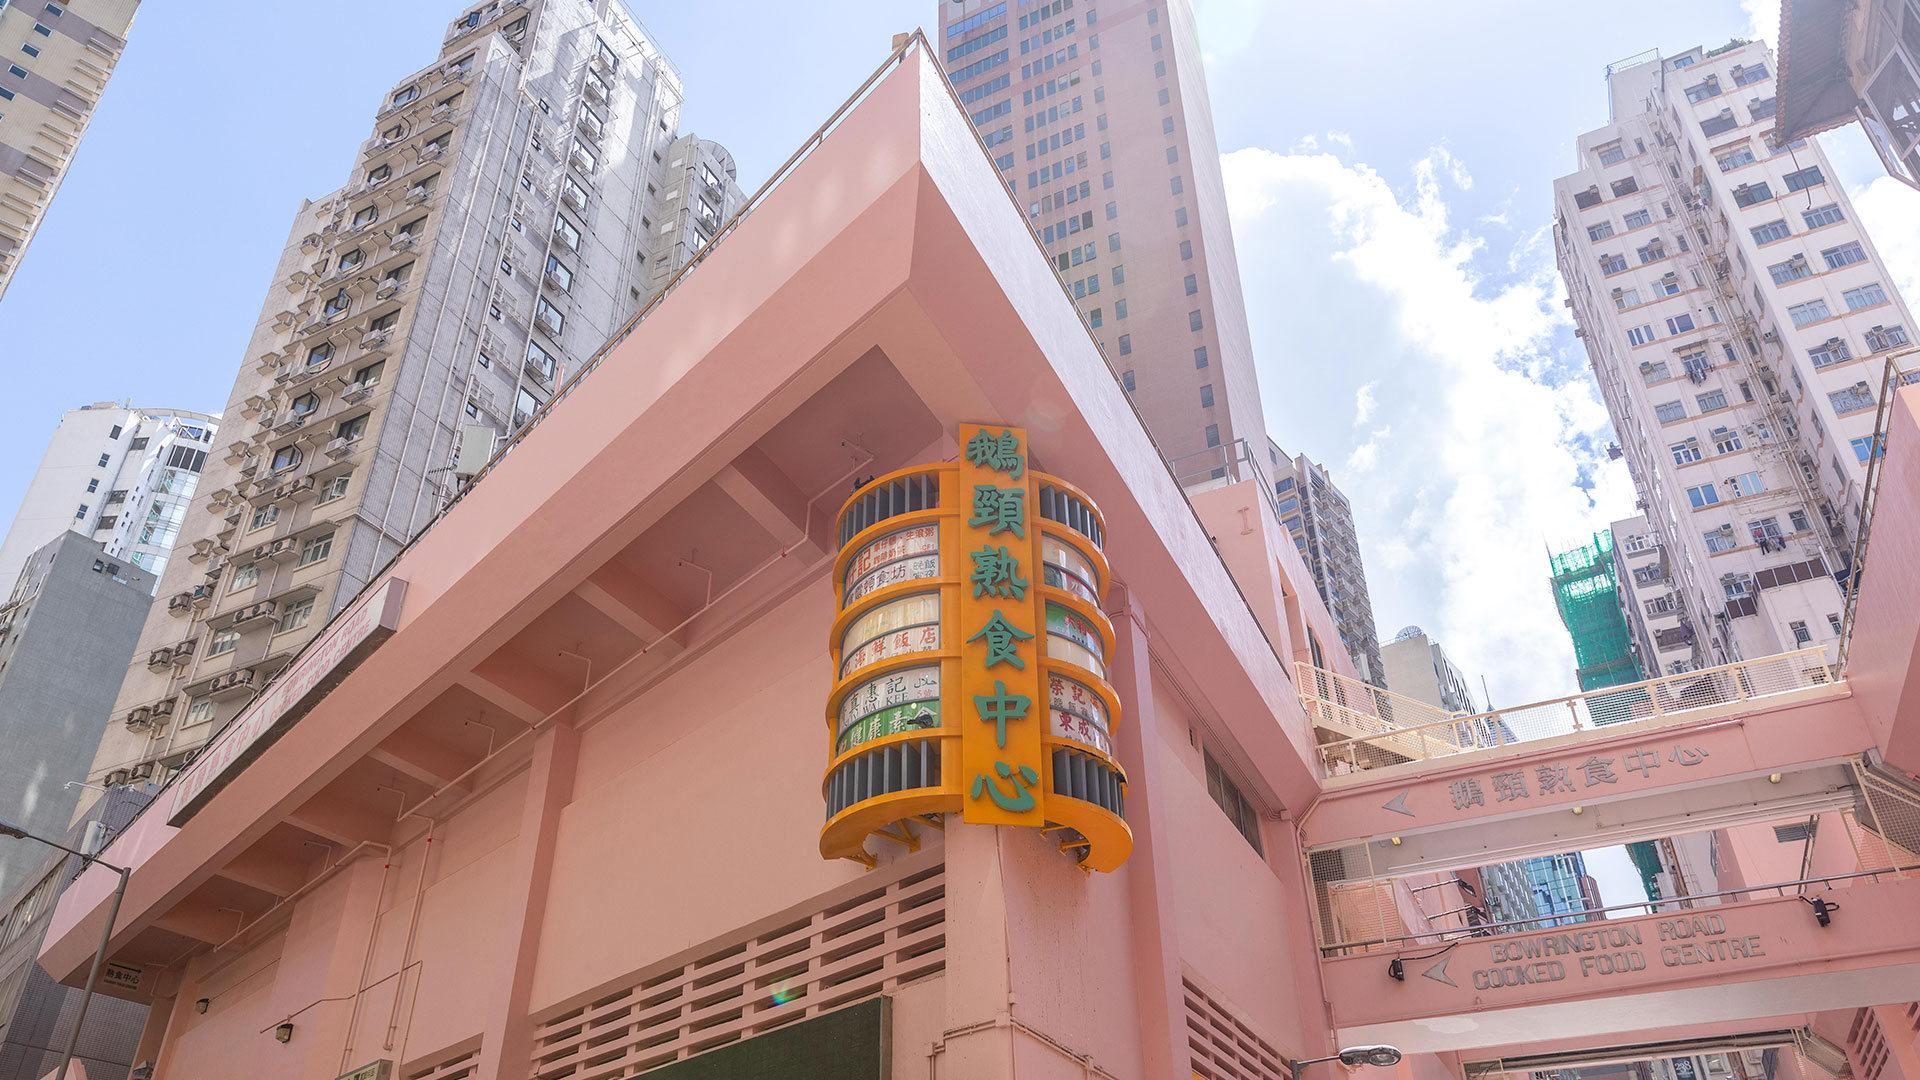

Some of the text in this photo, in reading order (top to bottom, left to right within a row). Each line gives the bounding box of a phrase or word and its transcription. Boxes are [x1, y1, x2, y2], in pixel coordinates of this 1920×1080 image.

[965, 428, 1038, 813] 鵝頸熟食中心
[886, 691, 908, 706] KEE
[914, 677, 938, 689] حلال
[1448, 745, 1709, 811] 鵝頸熟食中心
[1472, 935, 1766, 991] COOKED FOOD CENTRE
[1489, 913, 1727, 963] BOWRINGTON ROAD
